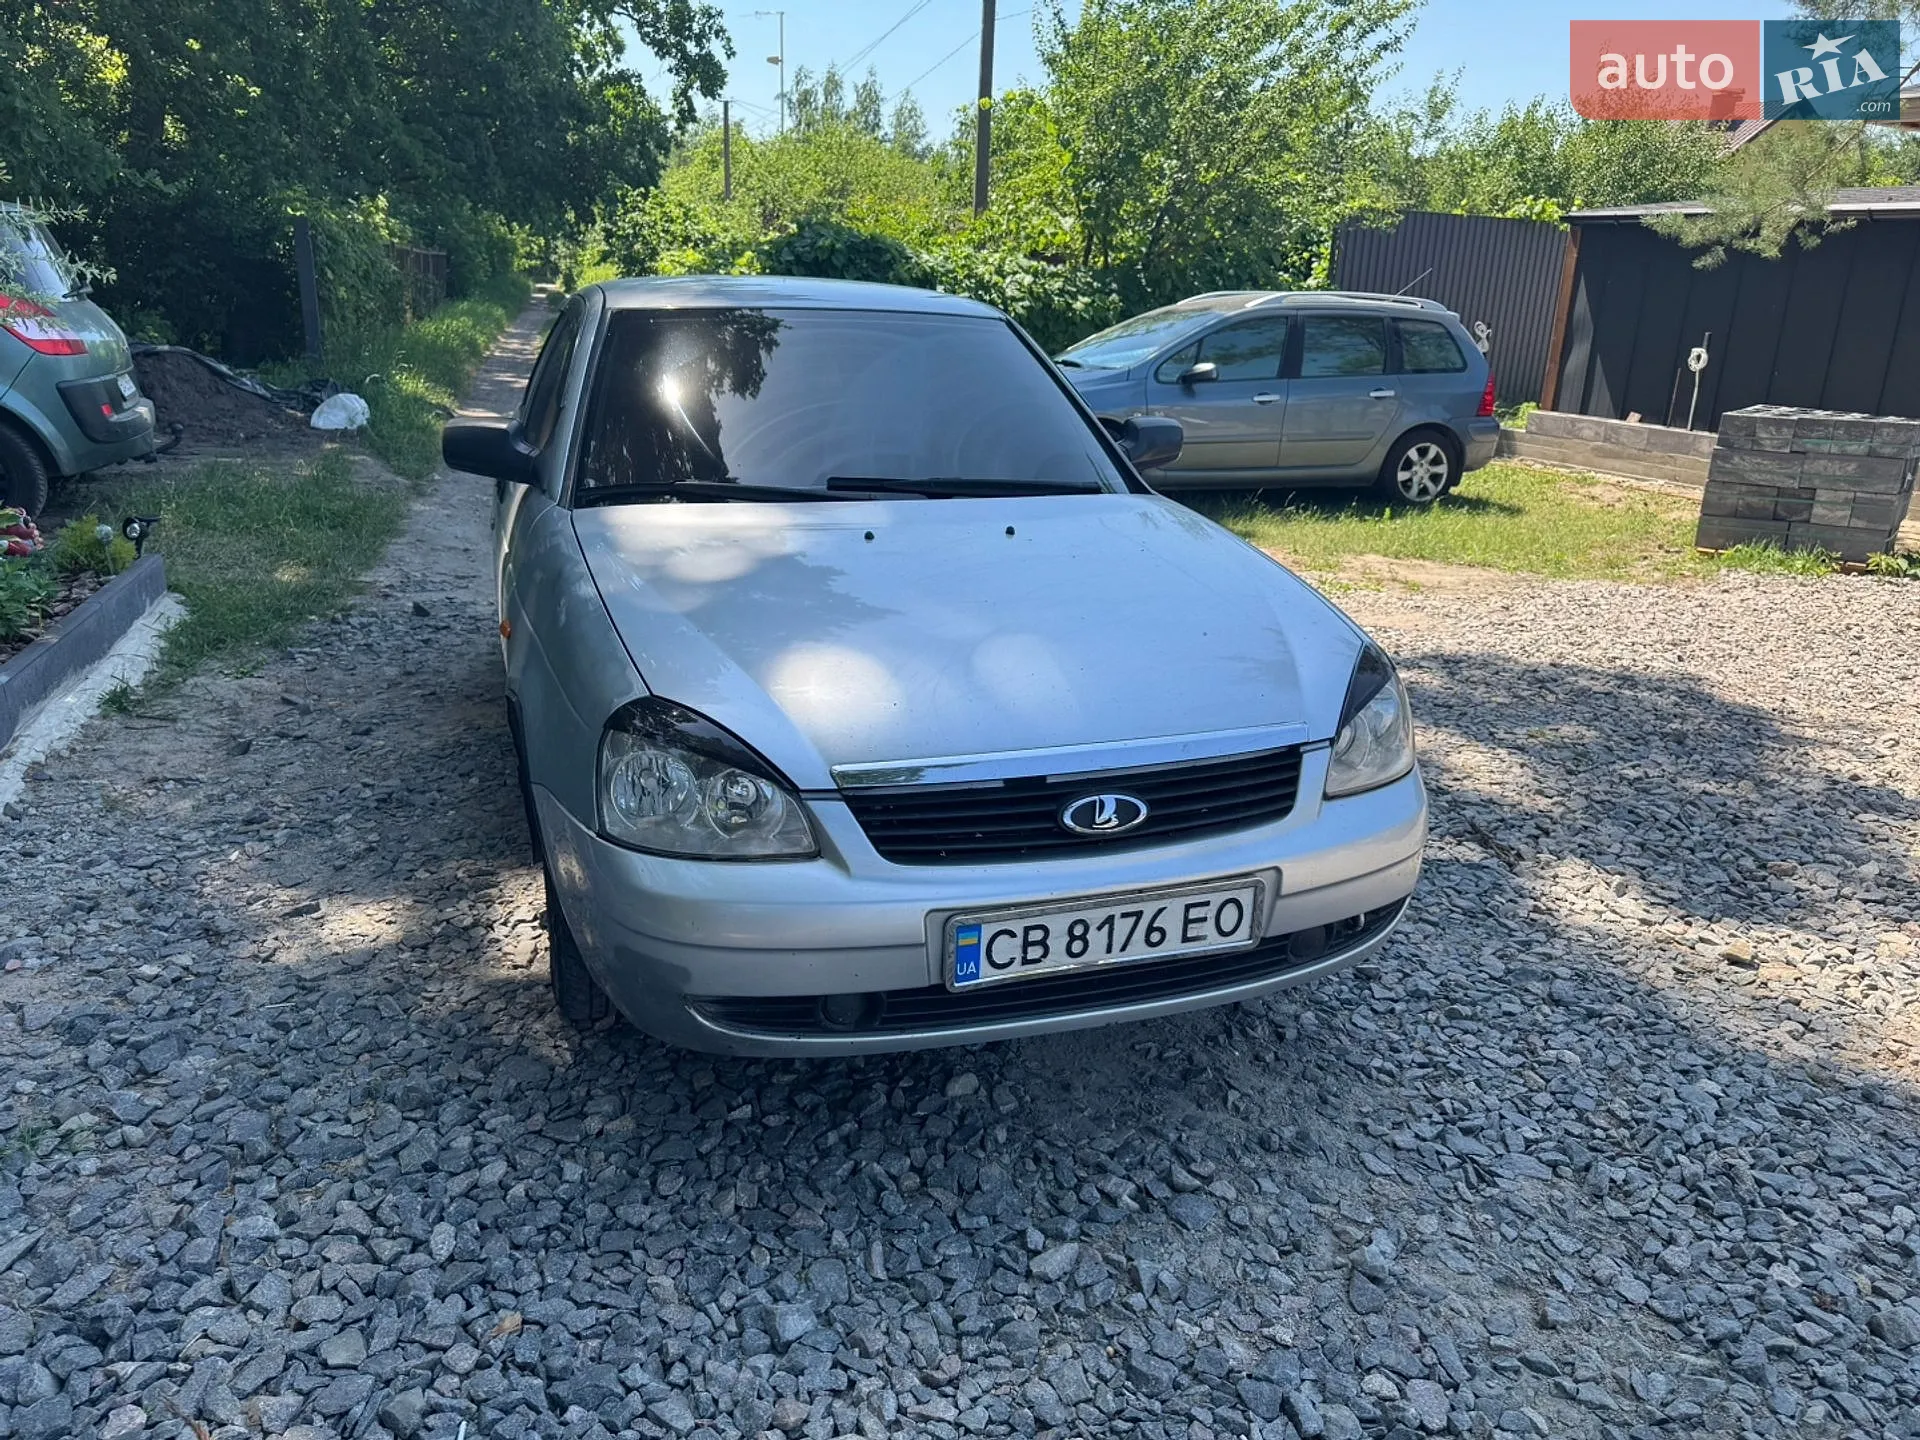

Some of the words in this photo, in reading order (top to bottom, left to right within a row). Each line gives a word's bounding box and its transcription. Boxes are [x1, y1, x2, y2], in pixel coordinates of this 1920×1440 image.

[985, 924, 1050, 970] CB
[1065, 906, 1167, 959] 8176
[1181, 897, 1244, 943] EO
[956, 961, 977, 976] UA
